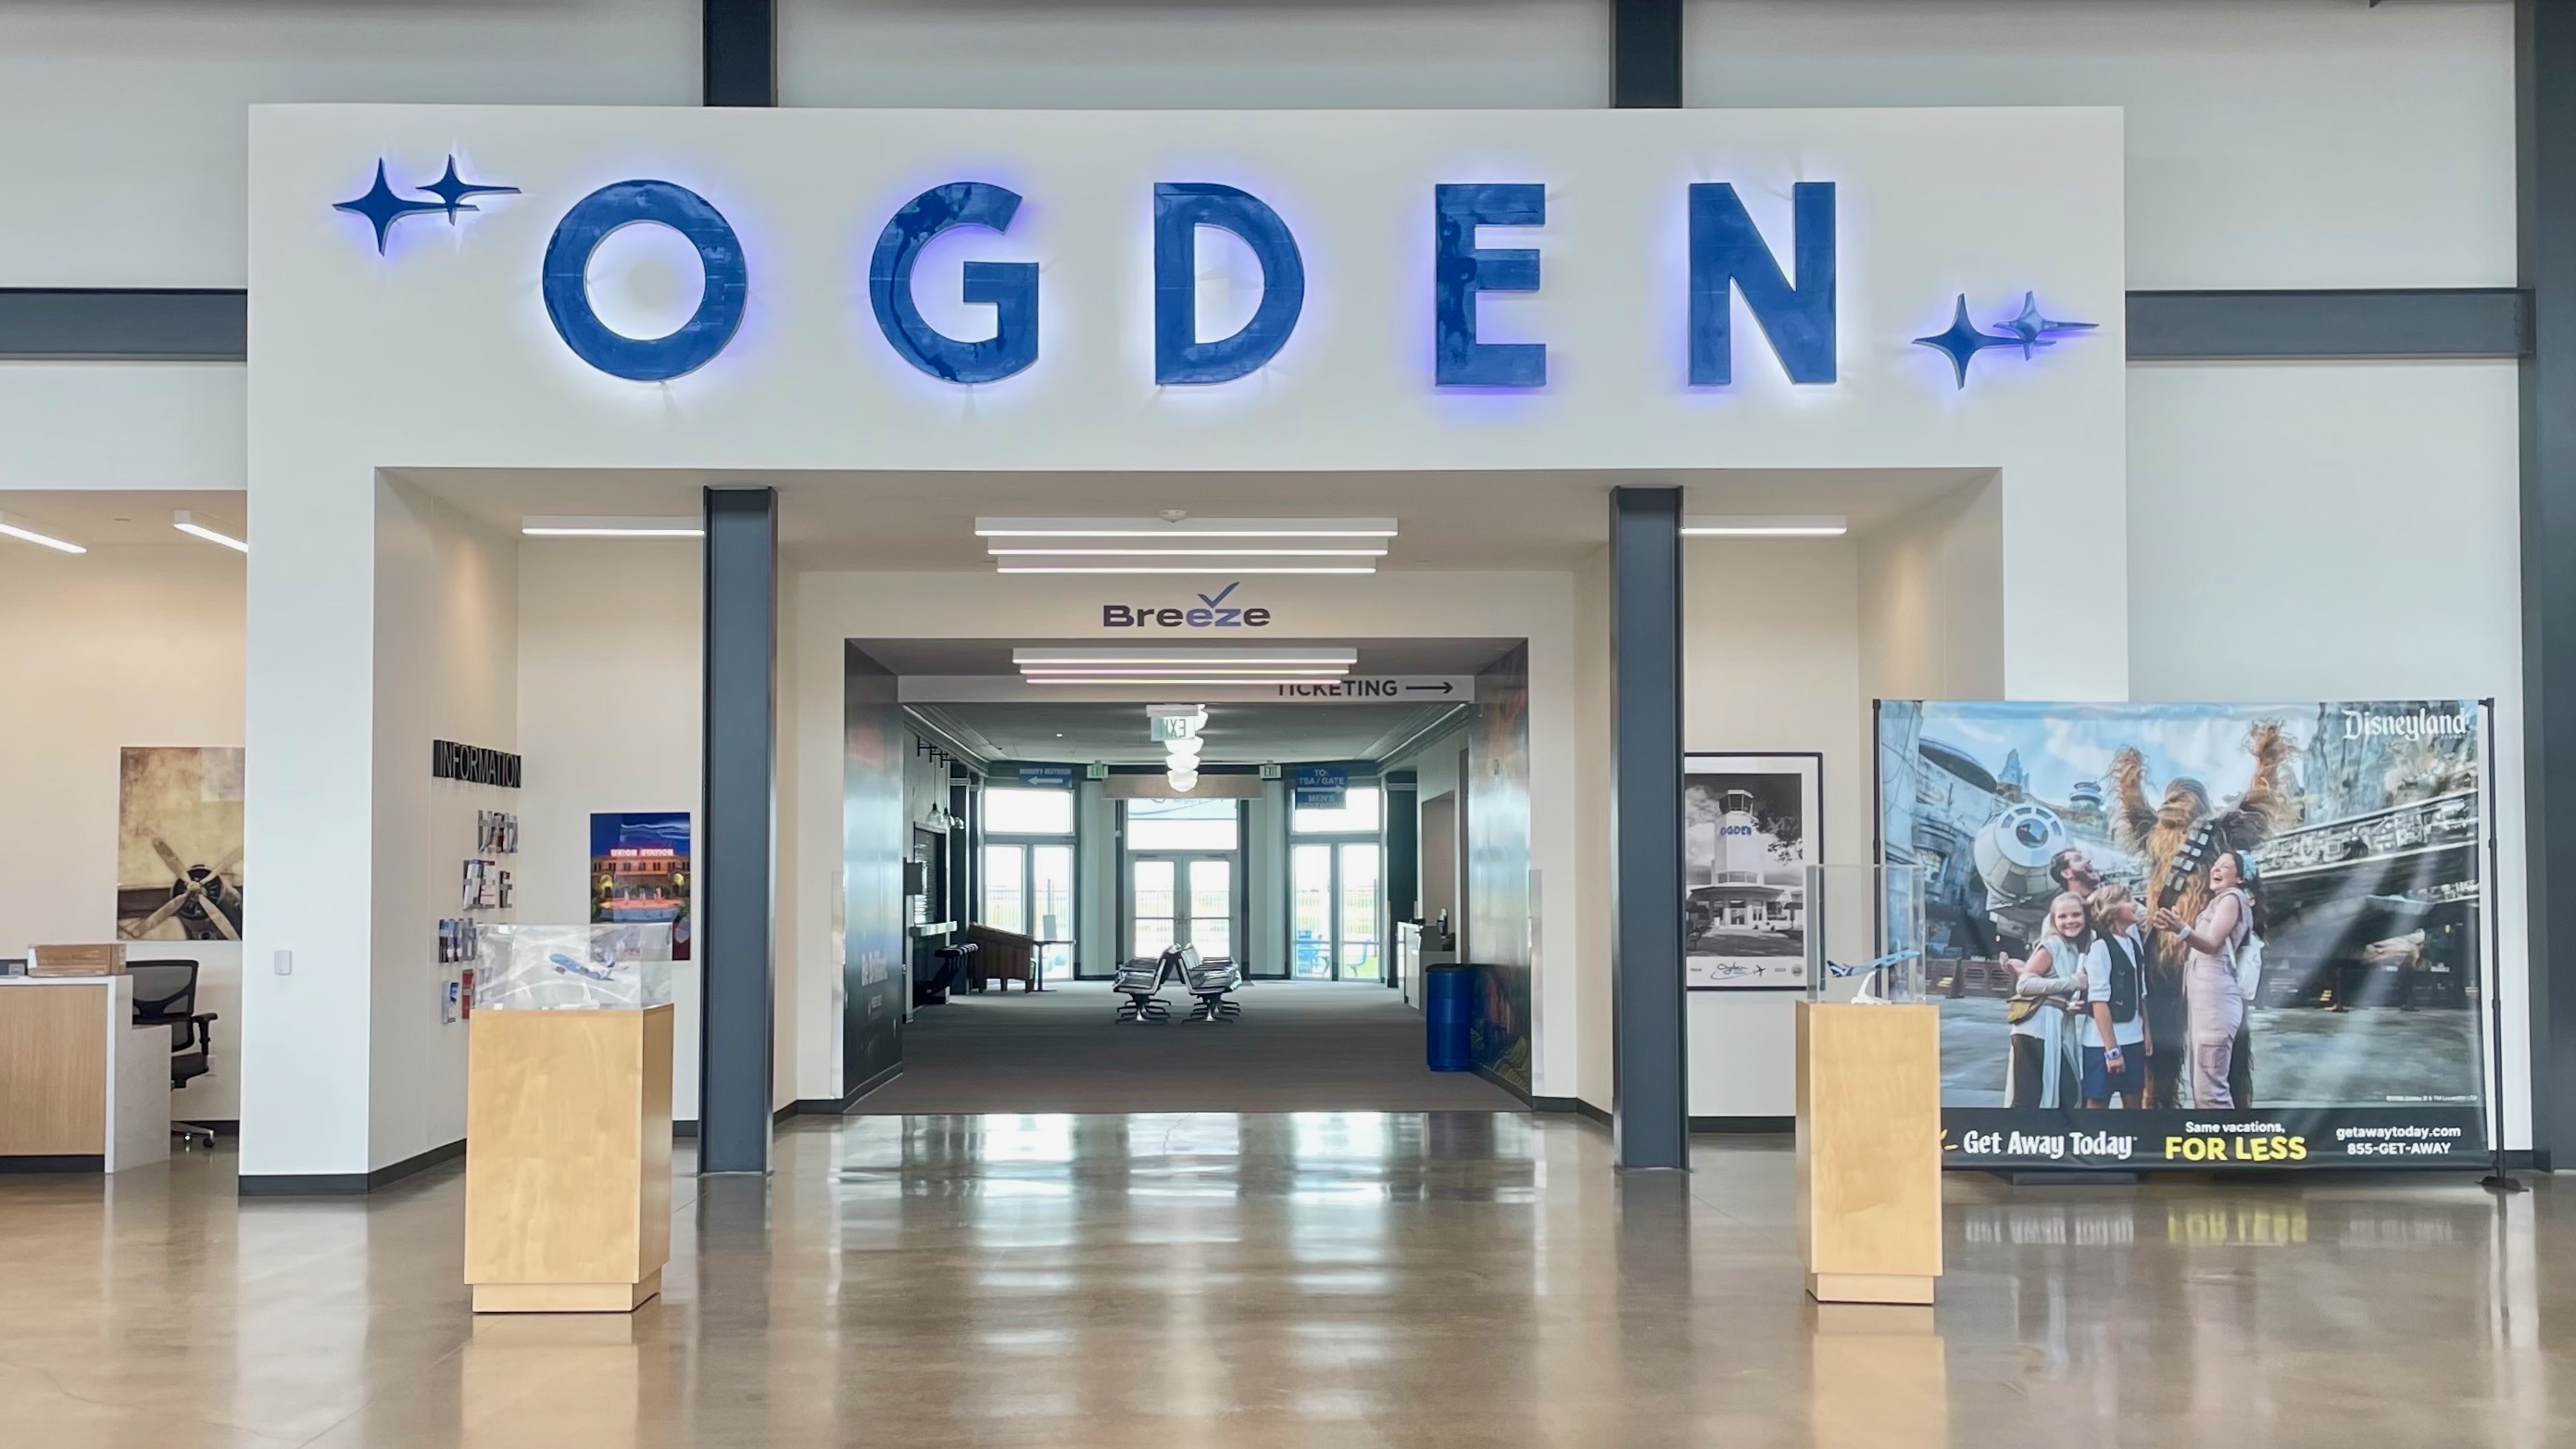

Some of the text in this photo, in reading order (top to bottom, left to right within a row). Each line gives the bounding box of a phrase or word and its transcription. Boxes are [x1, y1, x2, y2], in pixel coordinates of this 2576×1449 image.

[542, 178, 1837, 386] OGDEN
[1103, 605, 1271, 627] Breeze
[1278, 680, 1398, 697] TICKETING
[2341, 707, 2468, 741] Disneyland
[433, 739, 521, 788] INFORMATION
[1299, 777, 1315, 786] TSA
[1321, 777, 1345, 786] GATE
[2185, 1121, 2286, 1133] Same vacations,
[2335, 1125, 2461, 1140] getawaytoday.com
[1963, 1130, 2132, 1160] Get Away Today
[2165, 1136, 2307, 1161] FOR LESS
[2347, 1142, 2451, 1155] 855-GET-AWAY
